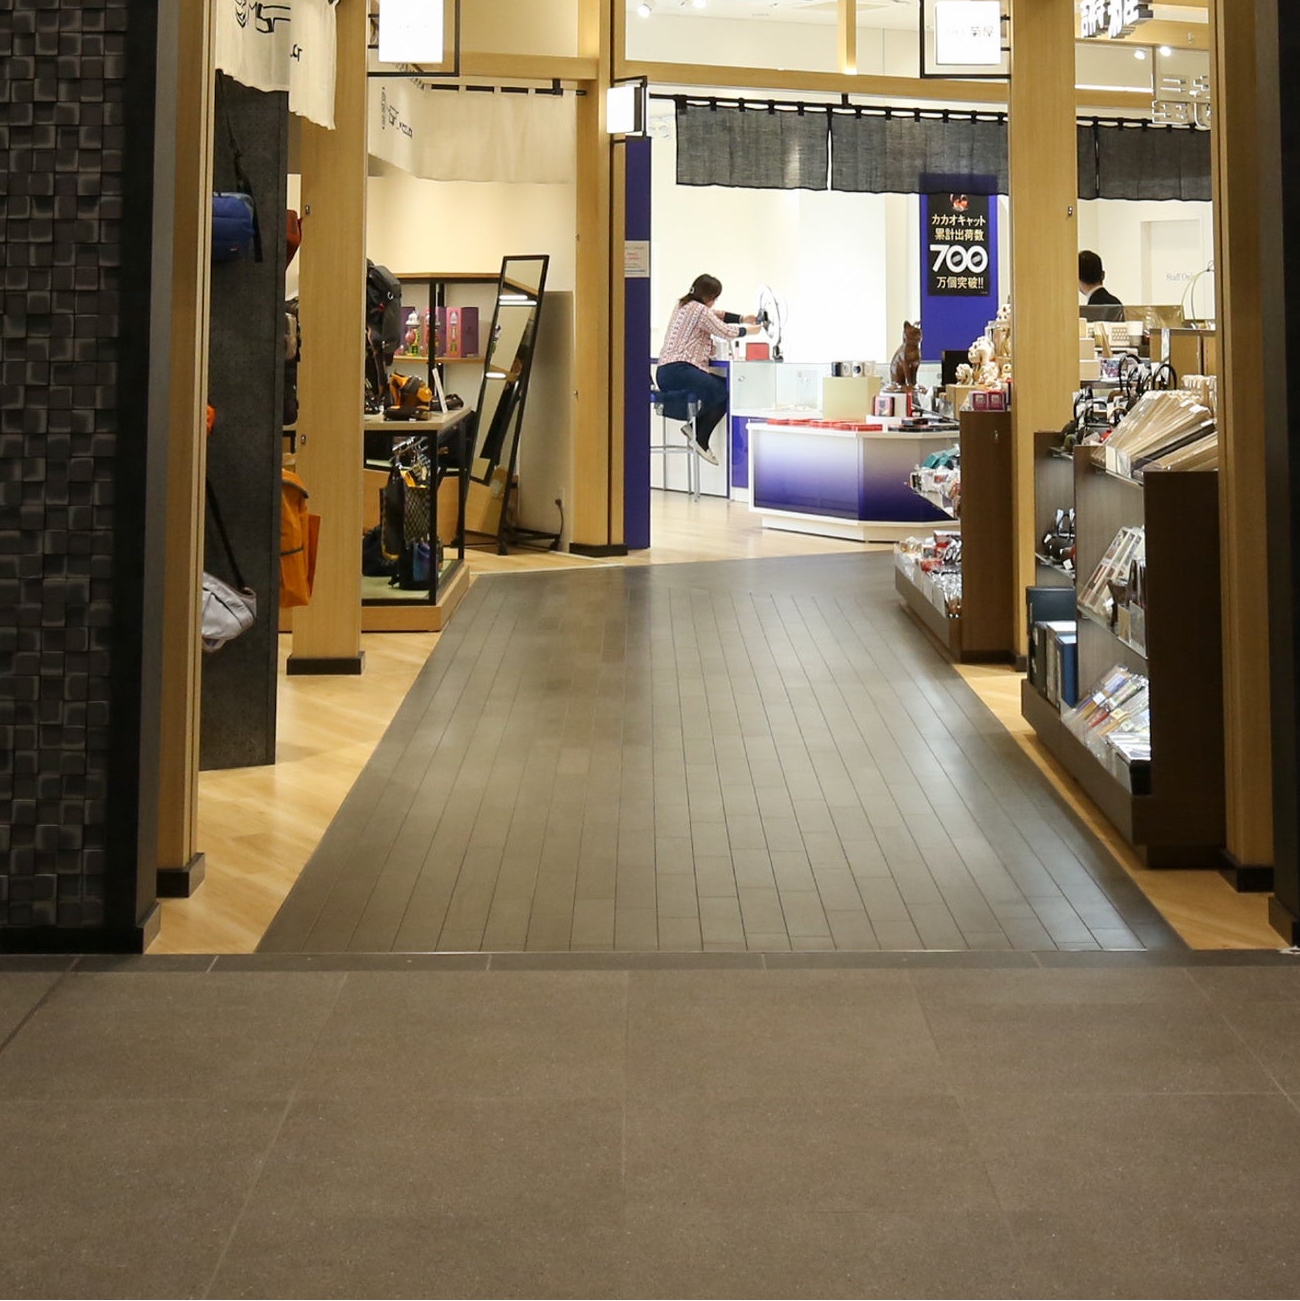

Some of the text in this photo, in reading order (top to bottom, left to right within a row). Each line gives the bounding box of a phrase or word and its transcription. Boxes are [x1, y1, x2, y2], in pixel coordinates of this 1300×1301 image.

[932, 214, 986, 226] カカオキャット
[935, 228, 984, 241] 累計出荷数
[929, 244, 988, 273] 700
[936, 276, 984, 289] 万個突破!!
